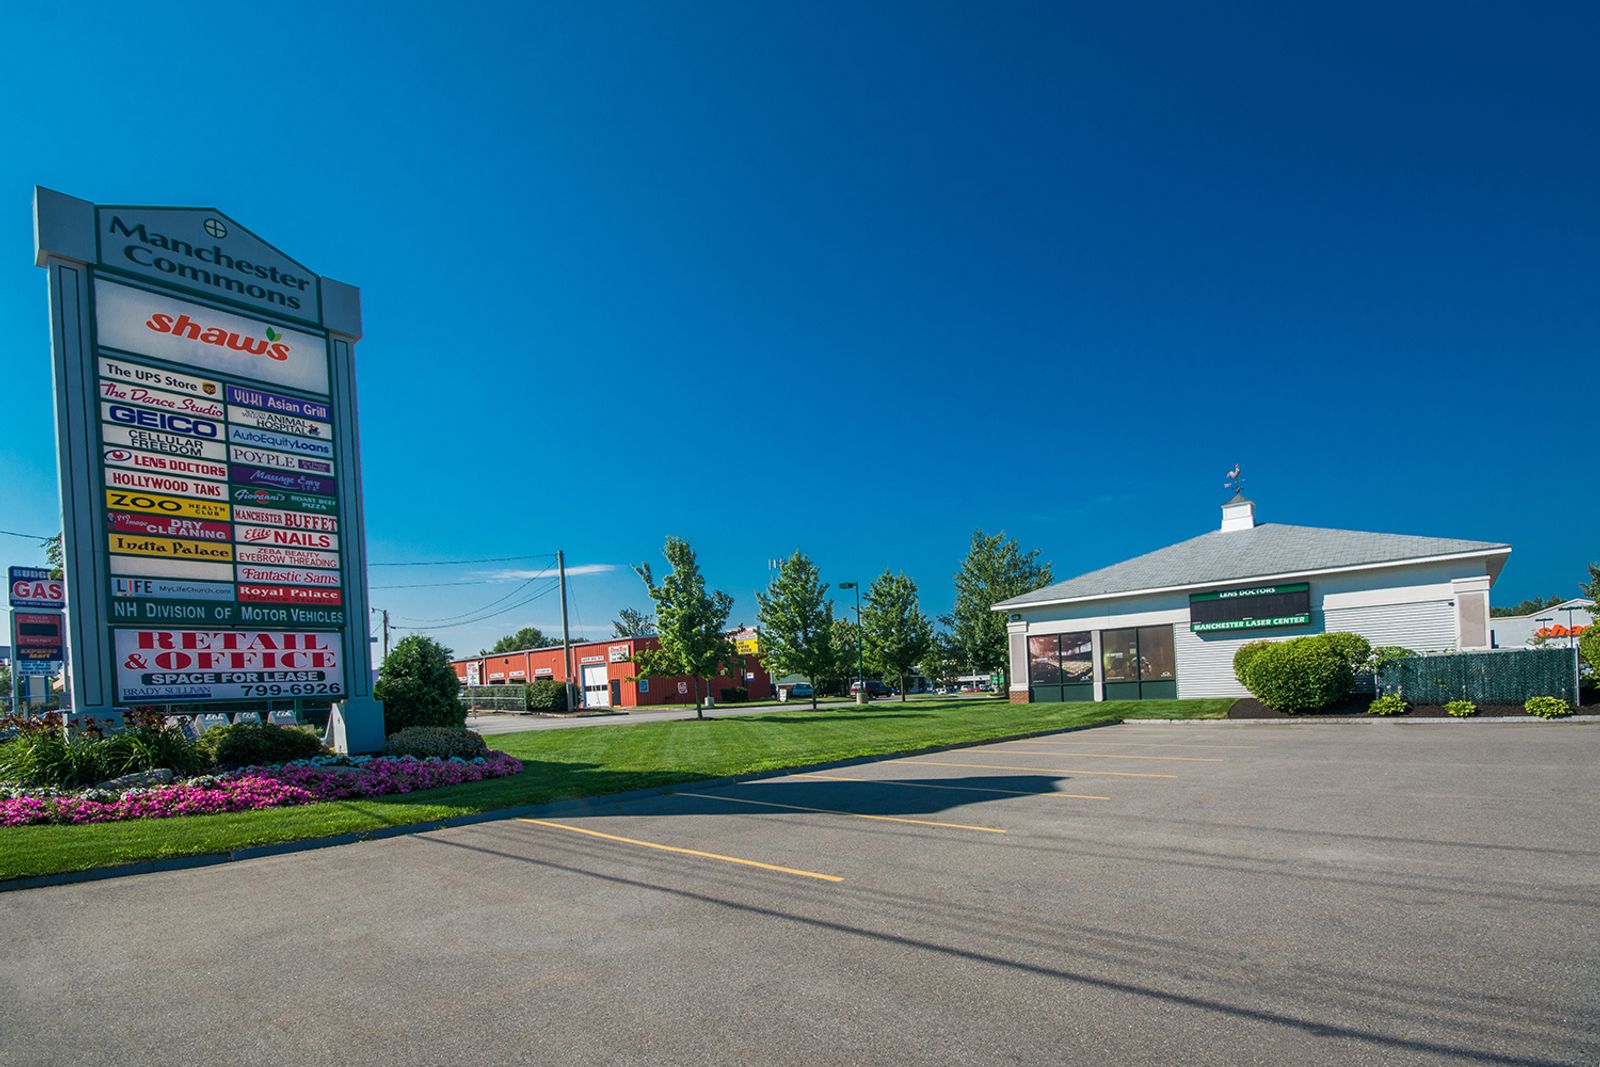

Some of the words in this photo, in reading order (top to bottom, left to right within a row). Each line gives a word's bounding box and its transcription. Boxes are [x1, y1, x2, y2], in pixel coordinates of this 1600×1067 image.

[110, 216, 309, 291] Manchester
[124, 245, 300, 309] Commons
[106, 363, 131, 377] The
[135, 370, 161, 383] UPS
[165, 376, 198, 391] Store
[100, 383, 127, 399] The
[131, 389, 175, 408] Dance
[177, 398, 223, 417] Studio
[234, 389, 262, 407] YUKI
[268, 397, 300, 413] Asian
[303, 404, 326, 418] Grill
[109, 405, 217, 438] GEICO
[257, 420, 308, 434] HOSPITAL
[266, 414, 308, 428] ANIMAL
[128, 429, 204, 449] CELLULAR
[131, 439, 202, 456] FREEDOM
[233, 429, 329, 454] AutoEquityLoans
[134, 455, 167, 468] LENS
[170, 460, 226, 477] DOCTORS
[234, 448, 296, 469] POYPLE
[113, 472, 189, 492] HOLLYWOOD
[194, 483, 221, 497] TANS
[250, 470, 294, 485] Massage
[111, 493, 182, 511] ZOO
[234, 489, 286, 501] Giovanni's
[291, 495, 317, 504] ROAST
[188, 503, 226, 512] HEALTH
[171, 519, 202, 529] DRY
[235, 509, 283, 524] MANCHESTER
[284, 512, 337, 531] BUFFET
[146, 525, 227, 539] CLEANING
[244, 528, 272, 542] Elite
[274, 530, 331, 547] NAILS
[117, 538, 167, 553] India
[172, 542, 229, 557] Palace
[285, 549, 320, 557] BEAUTY
[240, 553, 286, 564] EYEBROW
[289, 557, 337, 568] THREADING
[242, 568, 301, 582] Fantastic
[304, 572, 338, 584] Sams
[13, 581, 62, 600] GAS
[159, 585, 231, 594] MyLifeChurch.com
[240, 586, 284, 597] Royal
[291, 589, 338, 599] Palace
[1239, 587, 1275, 596] DOCTORS
[114, 602, 137, 617] NH
[146, 603, 205, 618] DIVISION
[214, 607, 232, 619] OF
[241, 606, 287, 621] MOTOR
[290, 608, 343, 623] VEHICLES
[1193, 621, 1244, 631] MANCHESTER
[1246, 618, 1271, 627] LASER
[1273, 616, 1305, 625] CENTER
[138, 631, 329, 650] RETAIL
[124, 653, 149, 670] &
[155, 651, 337, 670] OFFICE
[151, 673, 216, 685] SPACE
[221, 672, 260, 684] FOR
[266, 671, 319, 682] LEASE
[124, 687, 161, 696] BRADY
[240, 683, 341, 697] 799-6926
